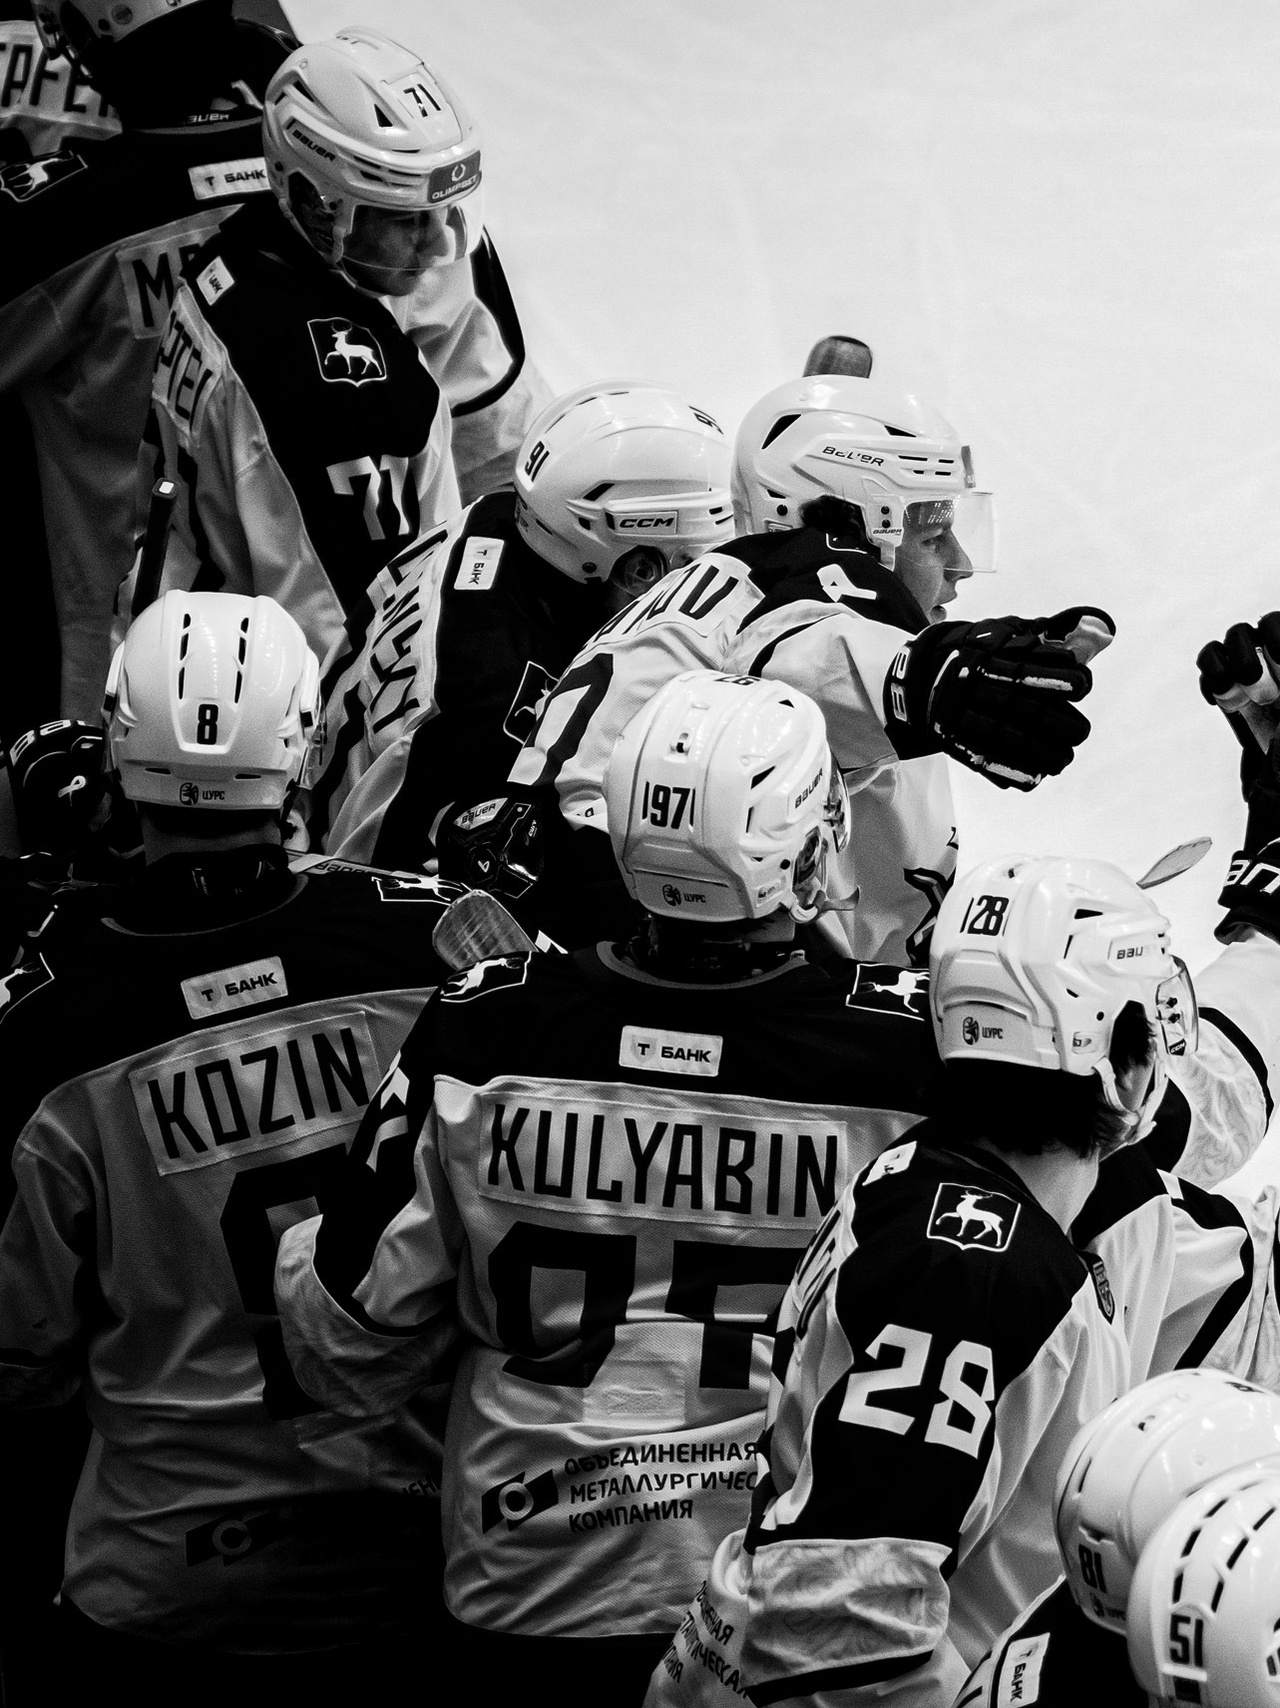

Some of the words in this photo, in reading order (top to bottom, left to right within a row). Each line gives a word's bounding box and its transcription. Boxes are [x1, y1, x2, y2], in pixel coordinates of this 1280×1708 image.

[404, 84, 441, 118] 71
[292, 129, 336, 162] BAUER
[224, 169, 266, 183] БАНК
[432, 173, 478, 200] OLIMPBET
[525, 441, 550, 482] 91
[823, 446, 884, 467] BAUER
[326, 454, 410, 540] 71
[619, 517, 675, 528] CCM
[197, 704, 219, 745] 8
[650, 784, 690, 829] 97
[795, 768, 823, 809] BAUER
[967, 895, 1009, 936] 28
[1117, 946, 1144, 960] BAU
[225, 972, 278, 997] БАНК
[660, 1045, 712, 1064] БАНК
[147, 1027, 371, 1159] KOZIN
[487, 1104, 838, 1217] KULYABIN
[838, 1323, 996, 1459] 28
[564, 1442, 758, 1476] ОБЪЕДИНЕННАЯ
[570, 1471, 758, 1504] МЕТАЛЛУРГИЧЕС
[569, 1499, 693, 1533] КОМПАНИЯ
[1079, 1543, 1107, 1593] 81
[1169, 1614, 1204, 1667] 51
[1010, 1662, 1027, 1702] БАНК
